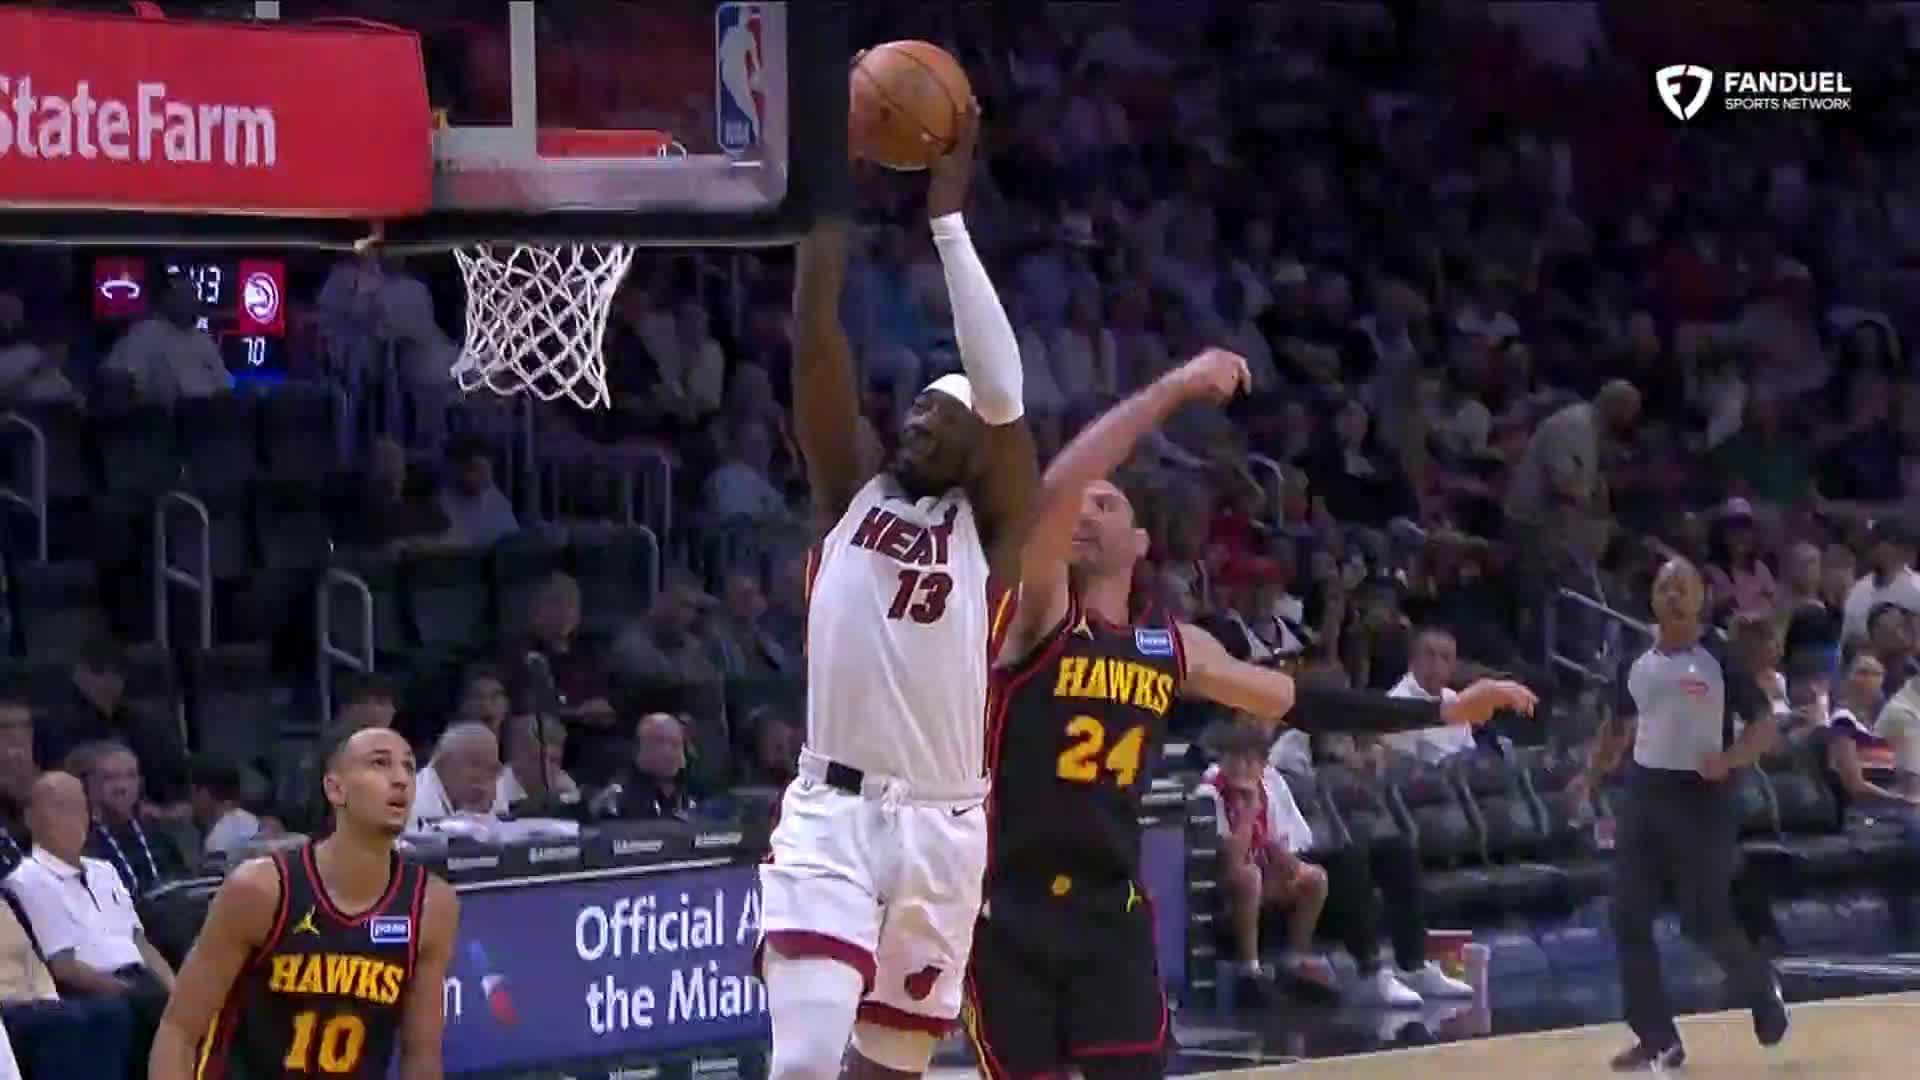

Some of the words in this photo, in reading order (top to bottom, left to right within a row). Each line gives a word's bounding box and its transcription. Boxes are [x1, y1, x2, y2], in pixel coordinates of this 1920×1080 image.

[242, 336, 265, 366] 70
[850, 506, 959, 566] HEAT
[887, 569, 954, 625] 13
[1055, 657, 1175, 716] HAWKS
[1057, 715, 1146, 788] 24
[575, 889, 725, 961] Official
[270, 952, 404, 1005] HAWKS
[586, 974, 654, 1035] the
[284, 1011, 366, 1073] 10
